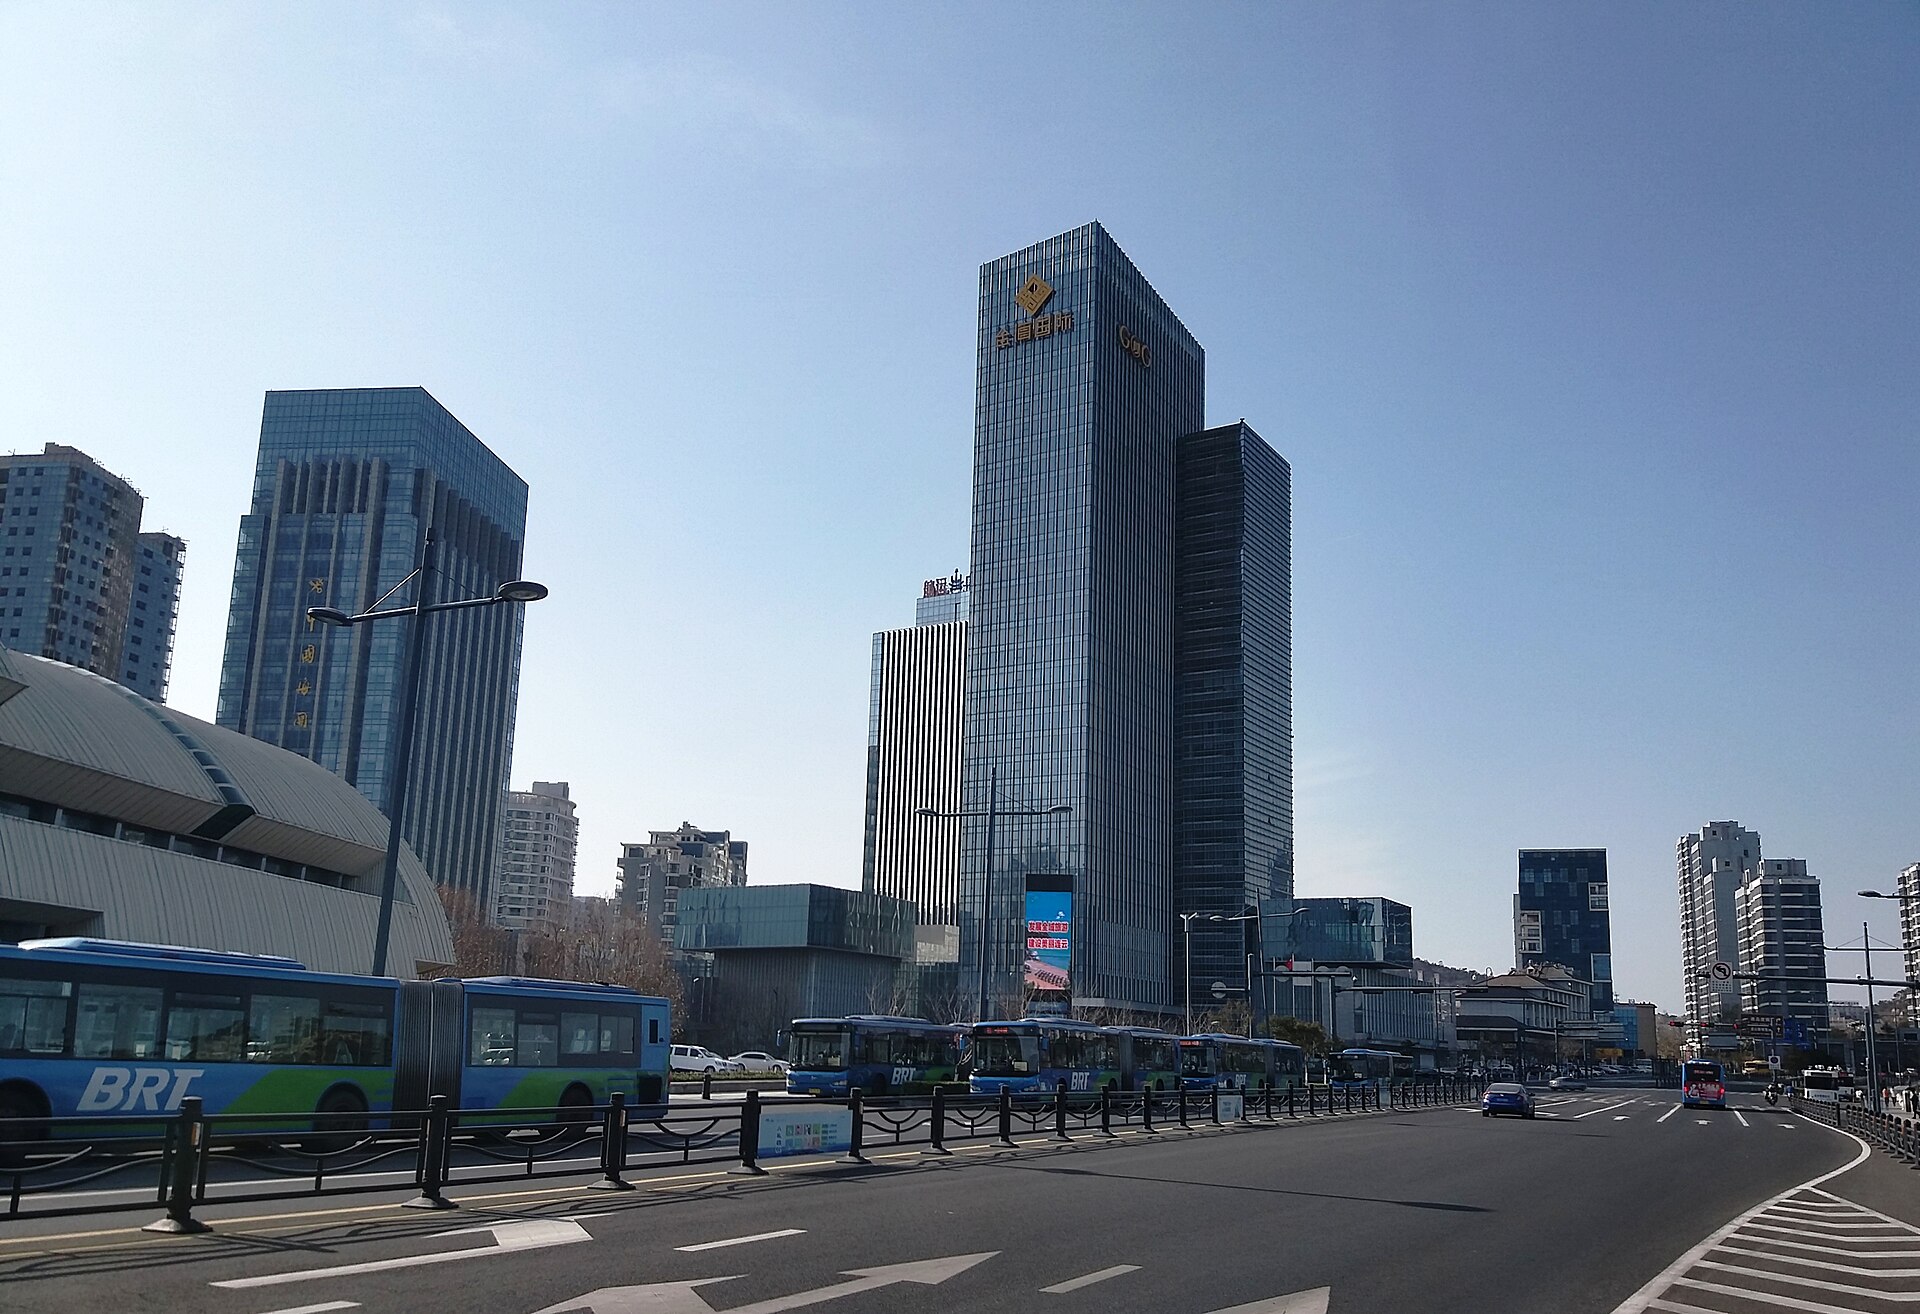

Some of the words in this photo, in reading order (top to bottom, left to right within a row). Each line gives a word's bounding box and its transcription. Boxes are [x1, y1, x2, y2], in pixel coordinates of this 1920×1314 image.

[891, 1067, 916, 1085] BRT
[1071, 1071, 1090, 1090] BRT
[76, 1067, 205, 1111] BRT
